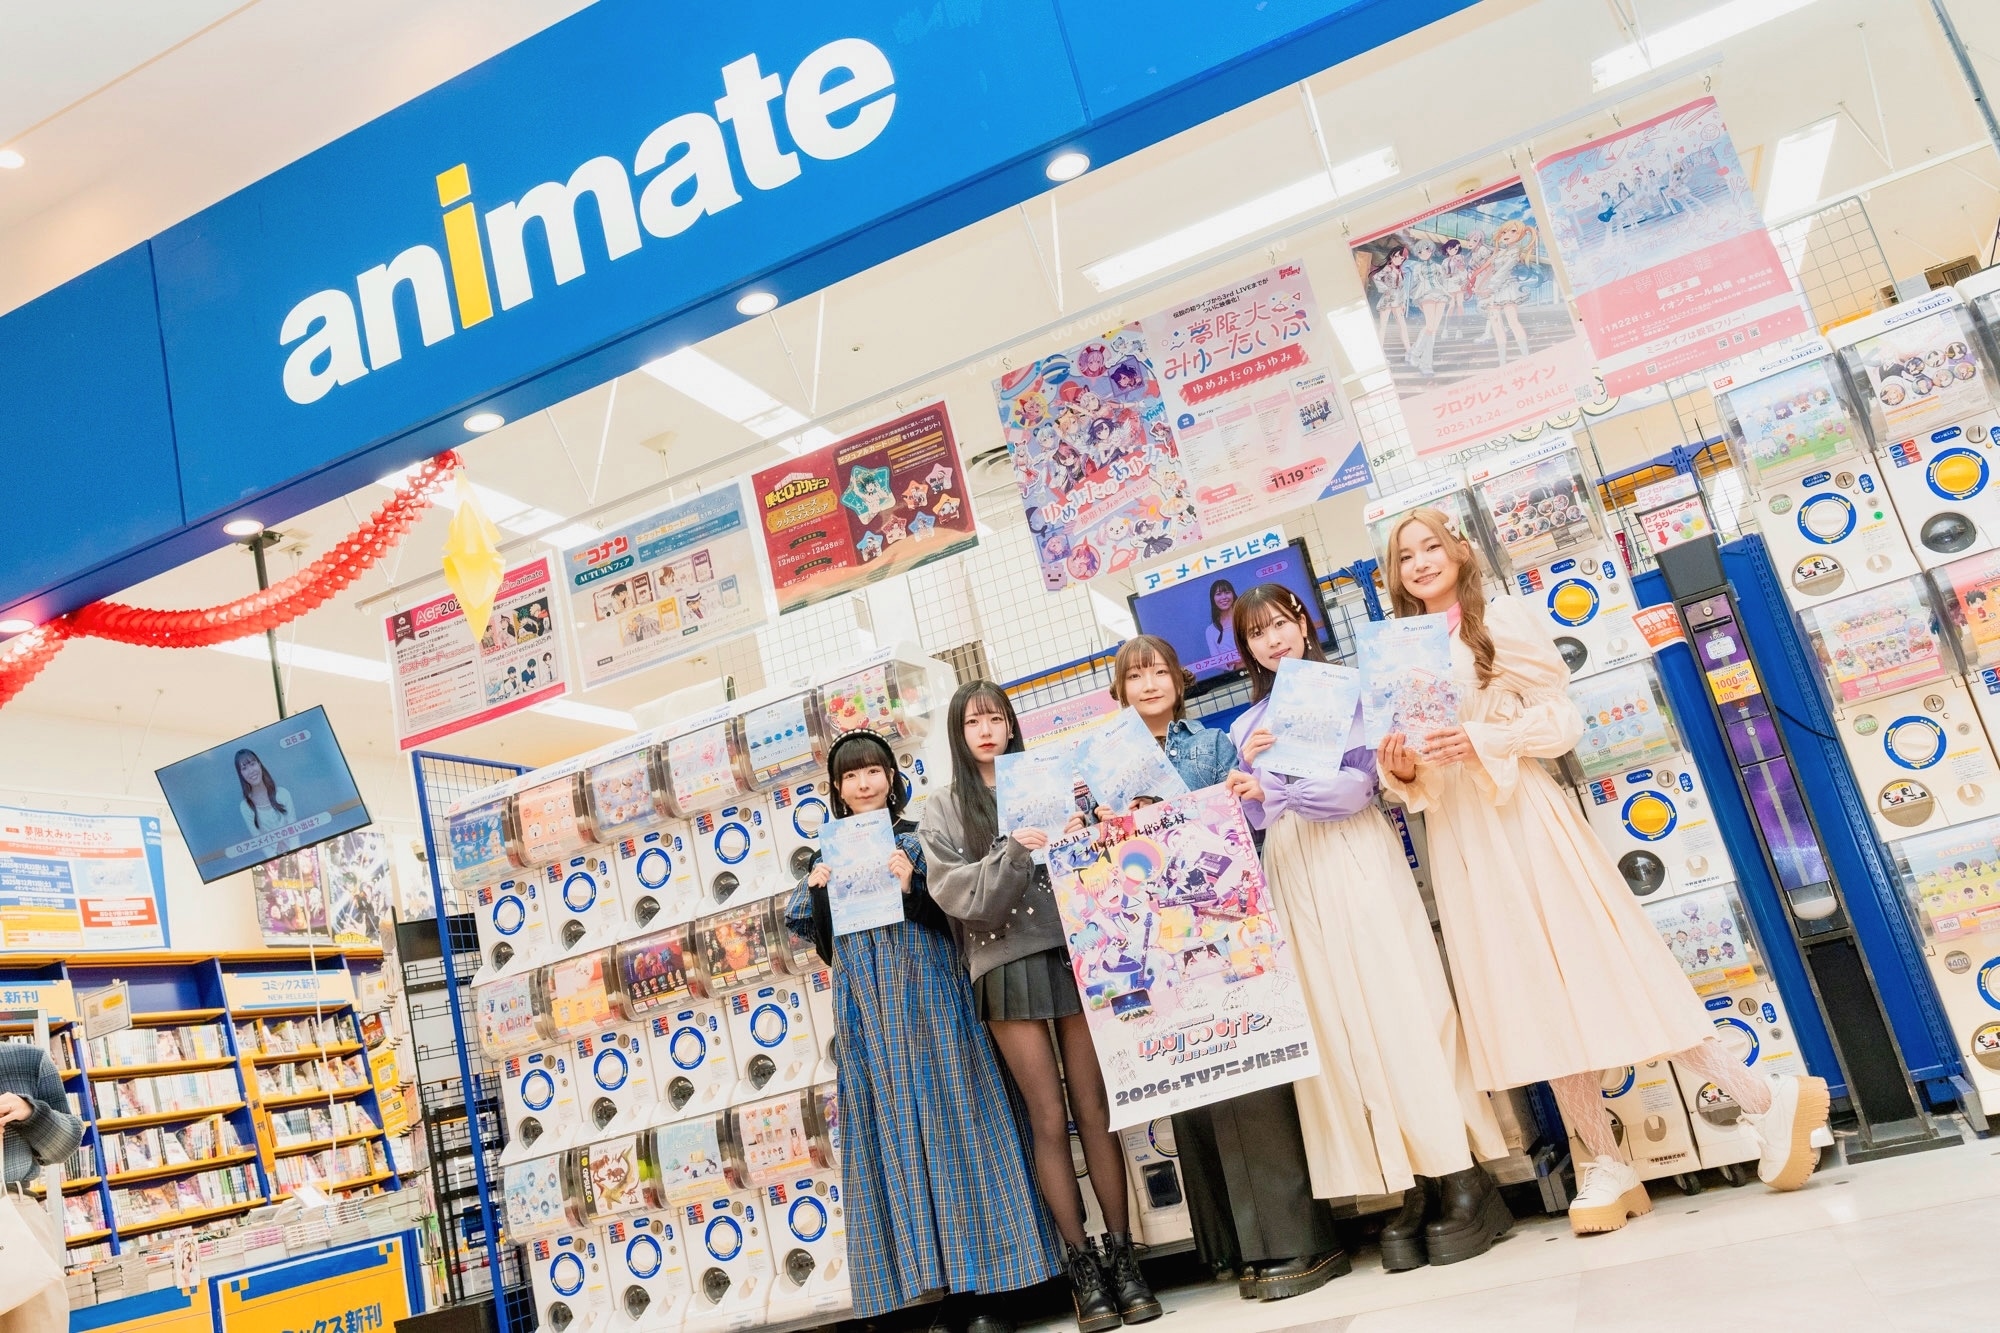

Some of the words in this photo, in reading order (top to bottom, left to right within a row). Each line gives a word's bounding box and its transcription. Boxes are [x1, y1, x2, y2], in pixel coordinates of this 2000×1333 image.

[280, 37, 896, 405] animate
[1187, 301, 1271, 345] 夢限大
[1600, 309, 1656, 335] 11月22日(土)
[1192, 351, 1293, 395] ゆめみたのあゆみ
[1433, 384, 1508, 419] プログレス
[1512, 365, 1557, 391] サイン
[1435, 409, 1502, 438] 2025.12.24
[1516, 394, 1536, 410] ON
[1538, 383, 1570, 405] SALE!
[1042, 444, 1163, 523] ゆめみたのあゆみ
[1271, 469, 1304, 489] 11.19
[776, 503, 829, 528] クリスマスフェア
[784, 498, 817, 517] ヒーローズ
[1640, 494, 1662, 508] こちら
[1643, 500, 1698, 525] カプセルのごみは
[1647, 519, 1670, 533] こちら
[587, 536, 629, 566] コナン
[1144, 556, 1217, 589] アニメイト
[1219, 540, 1261, 564] テレビ
[415, 597, 465, 626] AGF202
[25, 825, 112, 842] 夢限大みゅーたいぷ
[236, 817, 320, 853] Q.アニメイトでの思い出は?
[1948, 957, 1969, 969] ¥400
[0, 990, 39, 1004] 新刊
[261, 978, 320, 991] コミックス新刊
[1115, 1041, 1310, 1107] 2026年TVアニメ化決定!
[282, 1302, 383, 1333] クス新刊
